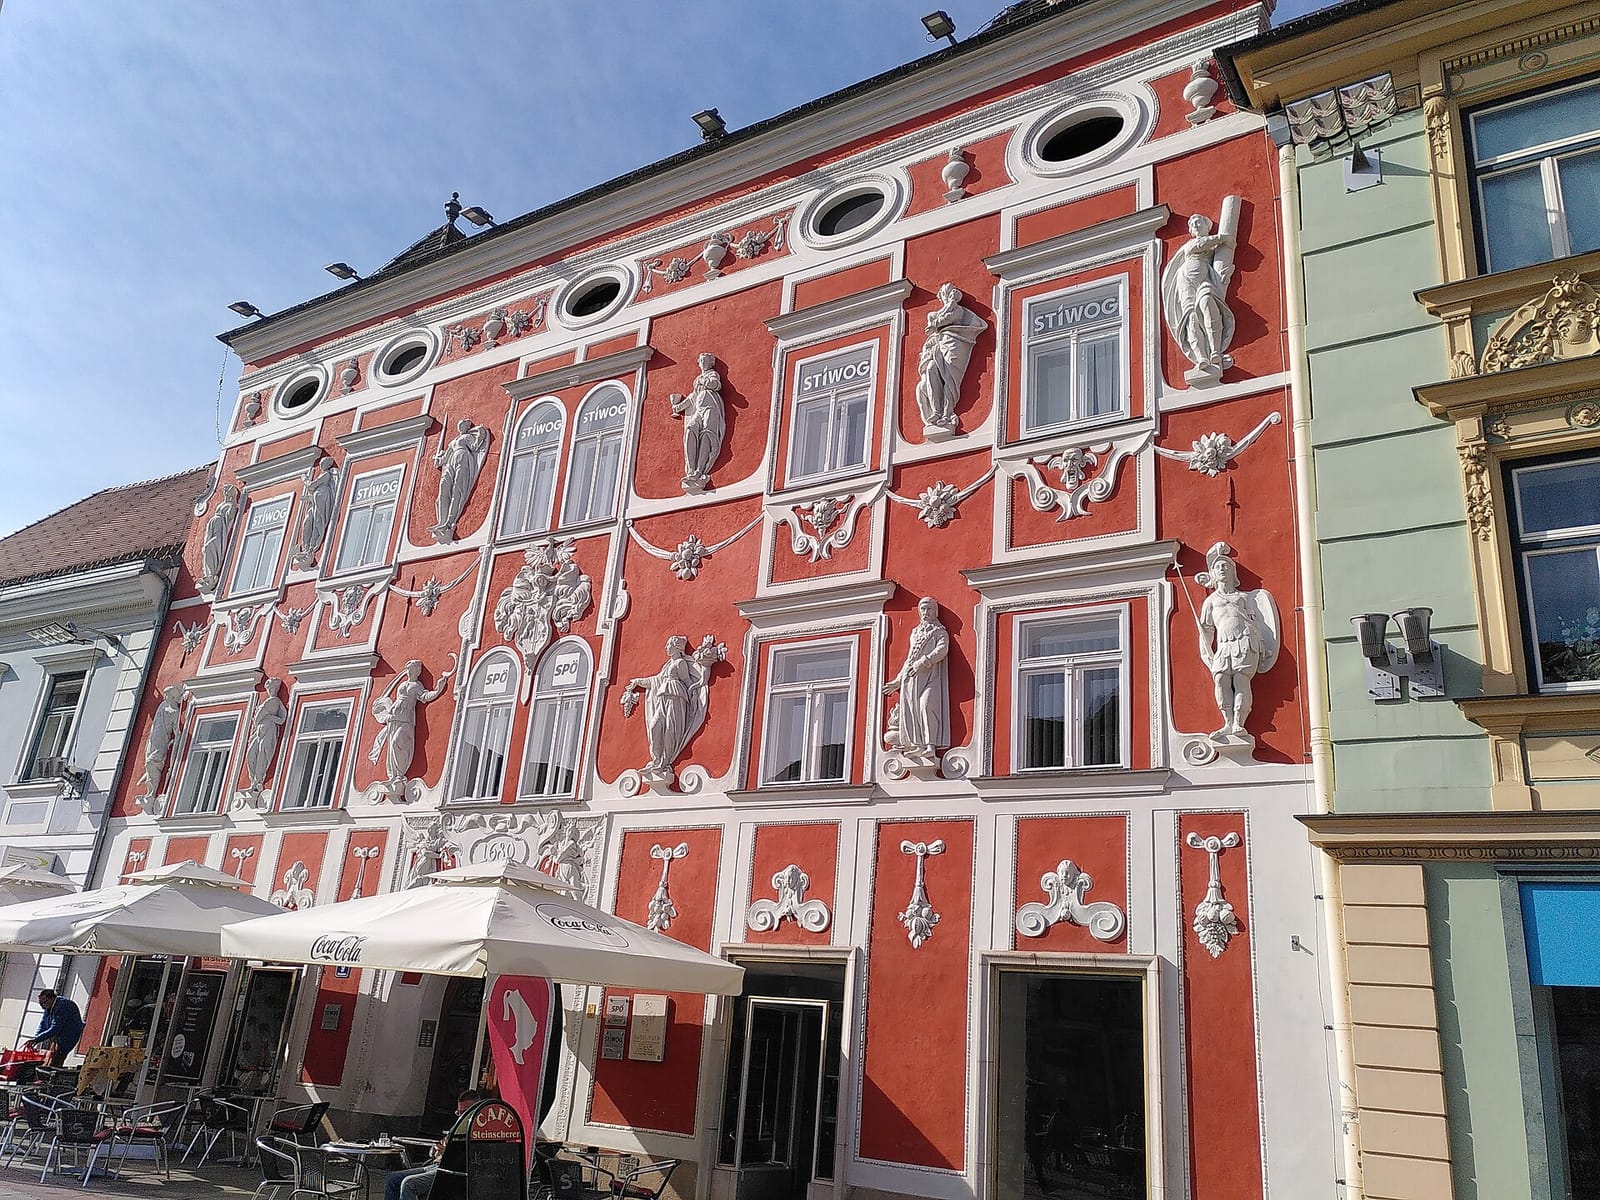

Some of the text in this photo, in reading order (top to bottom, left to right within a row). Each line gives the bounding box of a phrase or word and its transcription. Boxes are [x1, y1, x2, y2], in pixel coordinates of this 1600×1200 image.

[485, 669, 508, 685] SPÖ
[554, 660, 578, 677] SPÖ
[483, 842, 516, 862] 1680
[476, 1107, 514, 1128] CAFE
[472, 1130, 520, 1139] Steinscherer
